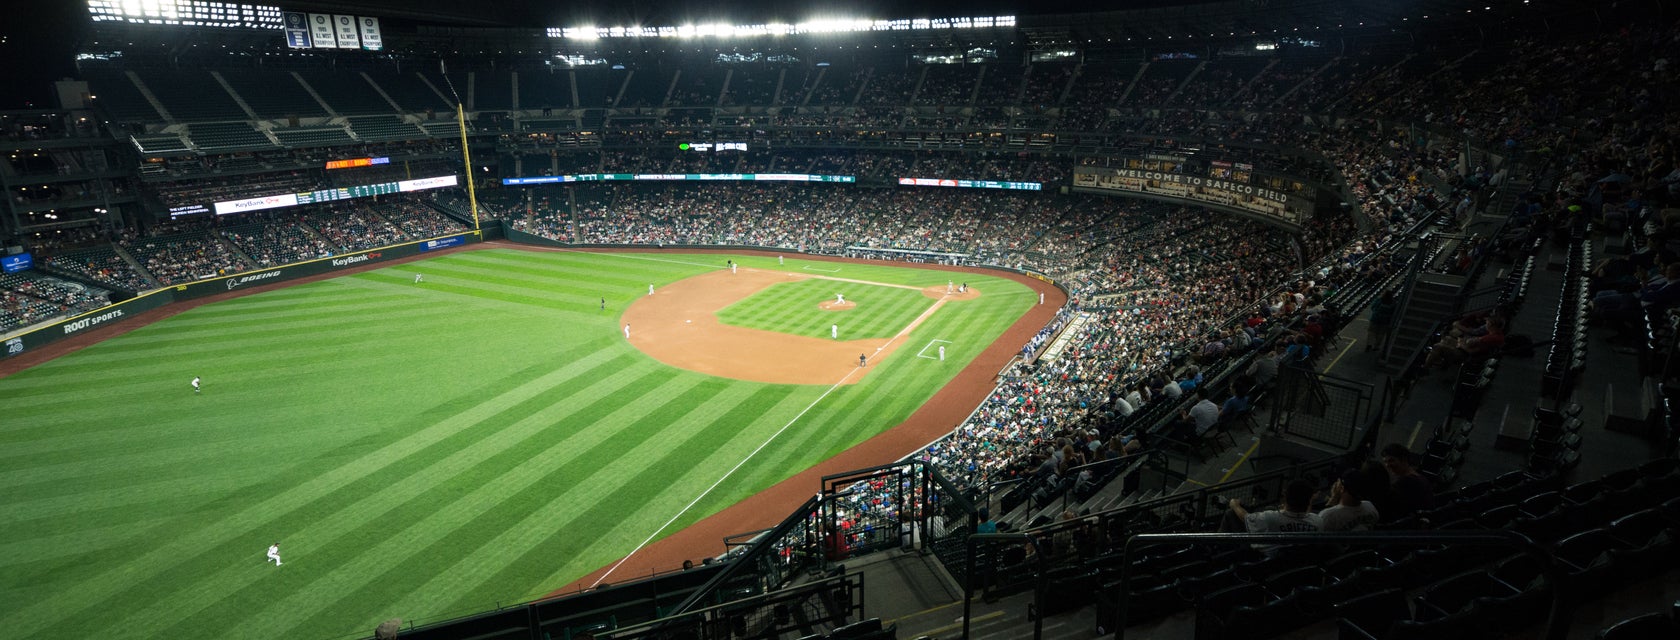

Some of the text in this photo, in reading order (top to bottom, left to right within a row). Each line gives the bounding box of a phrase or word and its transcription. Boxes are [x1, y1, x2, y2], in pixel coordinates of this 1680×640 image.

[1116, 169, 1287, 202] WELCOME TO SAFECO FIELD
[235, 200, 264, 208] KeyBank
[332, 254, 368, 266] KeyBank
[240, 270, 280, 283] BOEING
[64, 310, 122, 334] ROOT SPORTS
